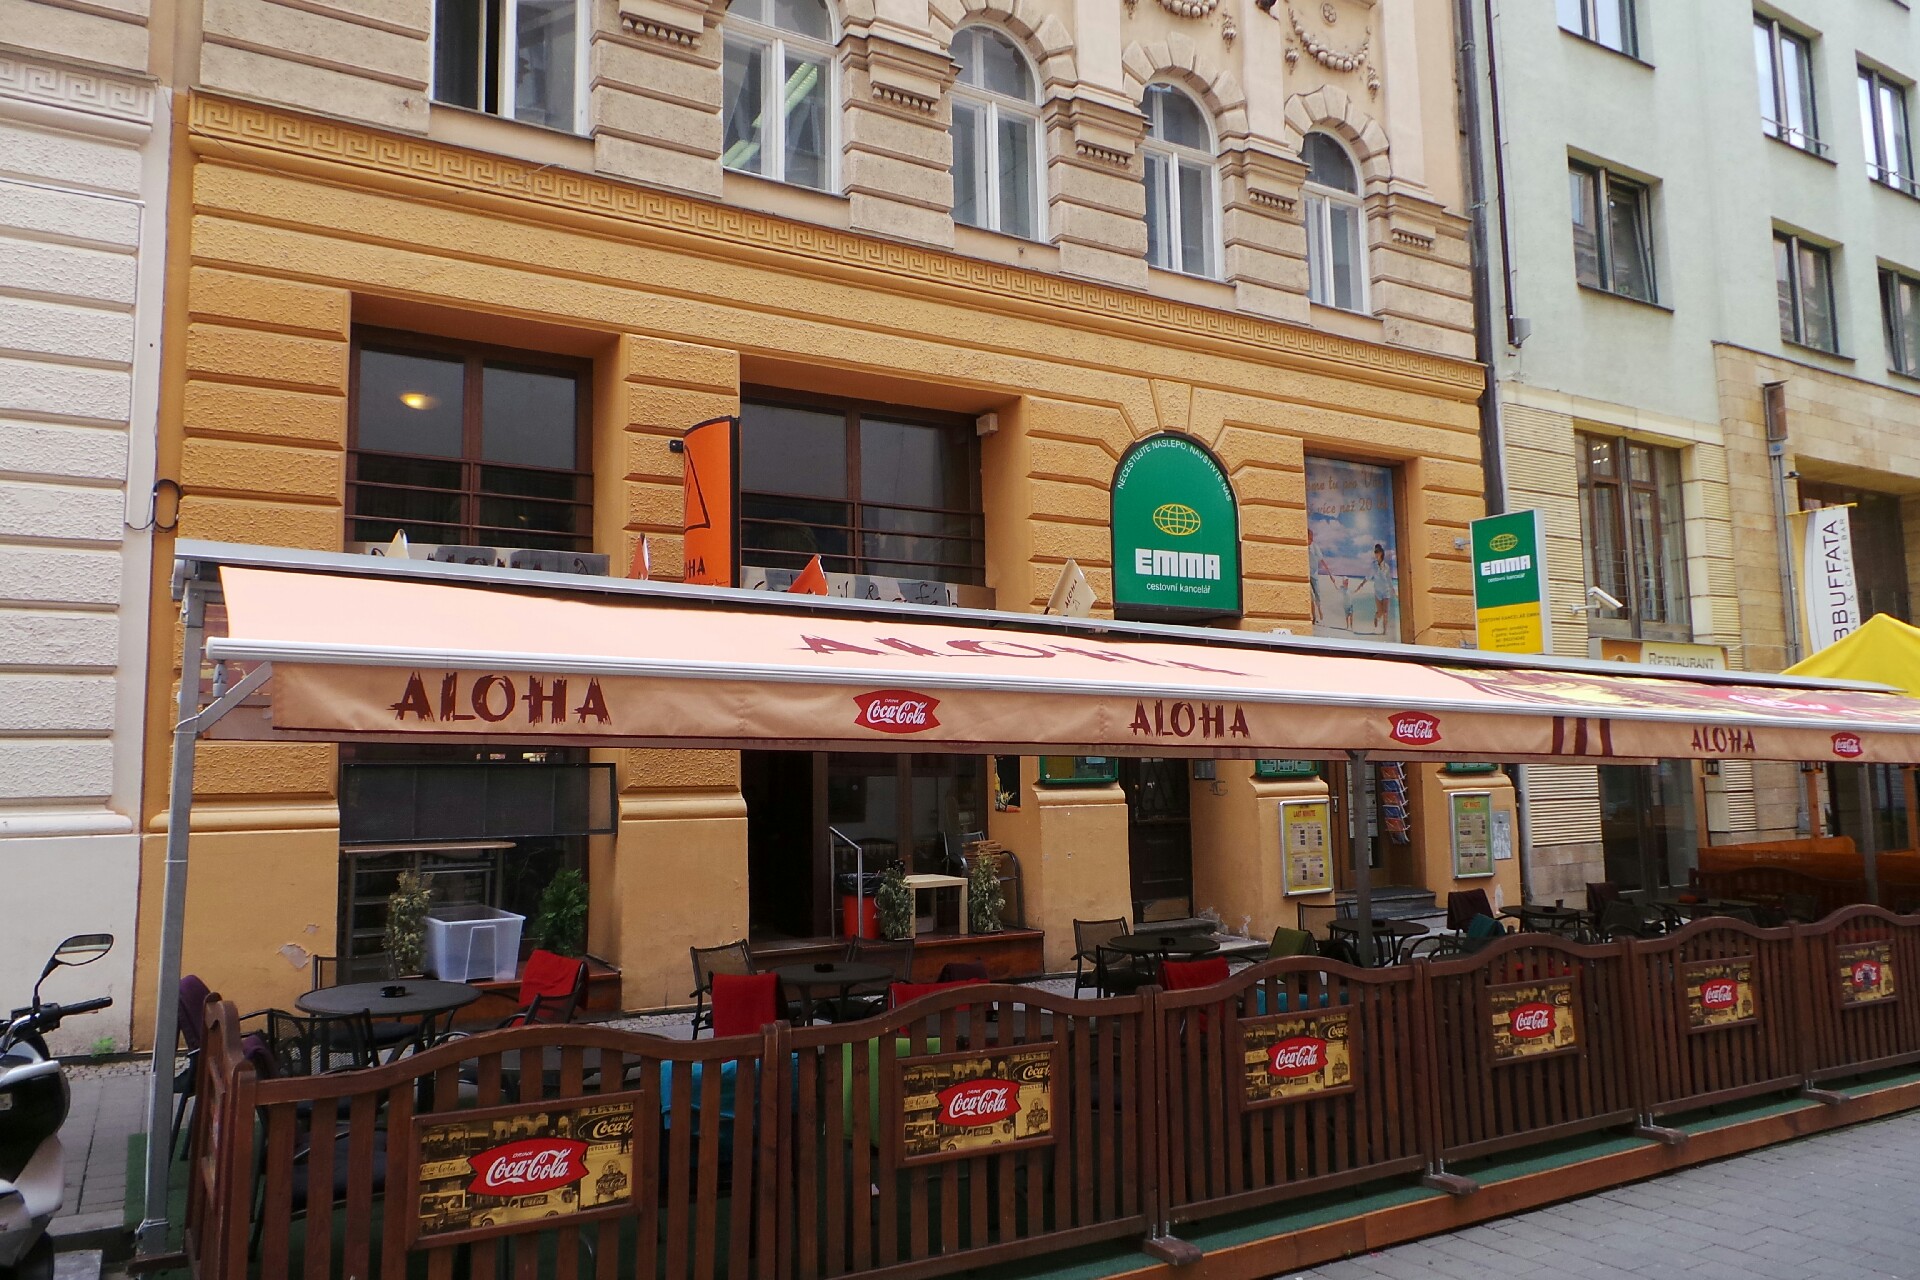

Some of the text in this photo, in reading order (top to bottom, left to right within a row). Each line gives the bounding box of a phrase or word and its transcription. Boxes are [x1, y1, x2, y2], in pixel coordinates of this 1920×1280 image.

[1117, 443, 1151, 489] NECESTUJTE
[1359, 496, 1372, 512] 20
[1840, 518, 1849, 540] BAR
[1135, 548, 1221, 580] EMMA
[1480, 555, 1531, 577] EMMA
[1146, 582, 1211, 594] cestovní kancelář
[796, 633, 1266, 678] ALOHA
[1648, 652, 1716, 669] RESTAURANT
[387, 670, 612, 726] ALOHA
[866, 699, 927, 725] Coca-Cola
[1127, 699, 1251, 739] ALOHA
[1396, 719, 1433, 740] Coca-Cola
[1692, 726, 1757, 753] ALOHA
[1705, 984, 1733, 1004] Coca-Cola
[1515, 1010, 1549, 1032] Coca-Cola
[1275, 1044, 1319, 1070] Coca-Cola
[949, 1087, 1009, 1119] Coca-Cola
[485, 1147, 573, 1187] Coca-Cola
